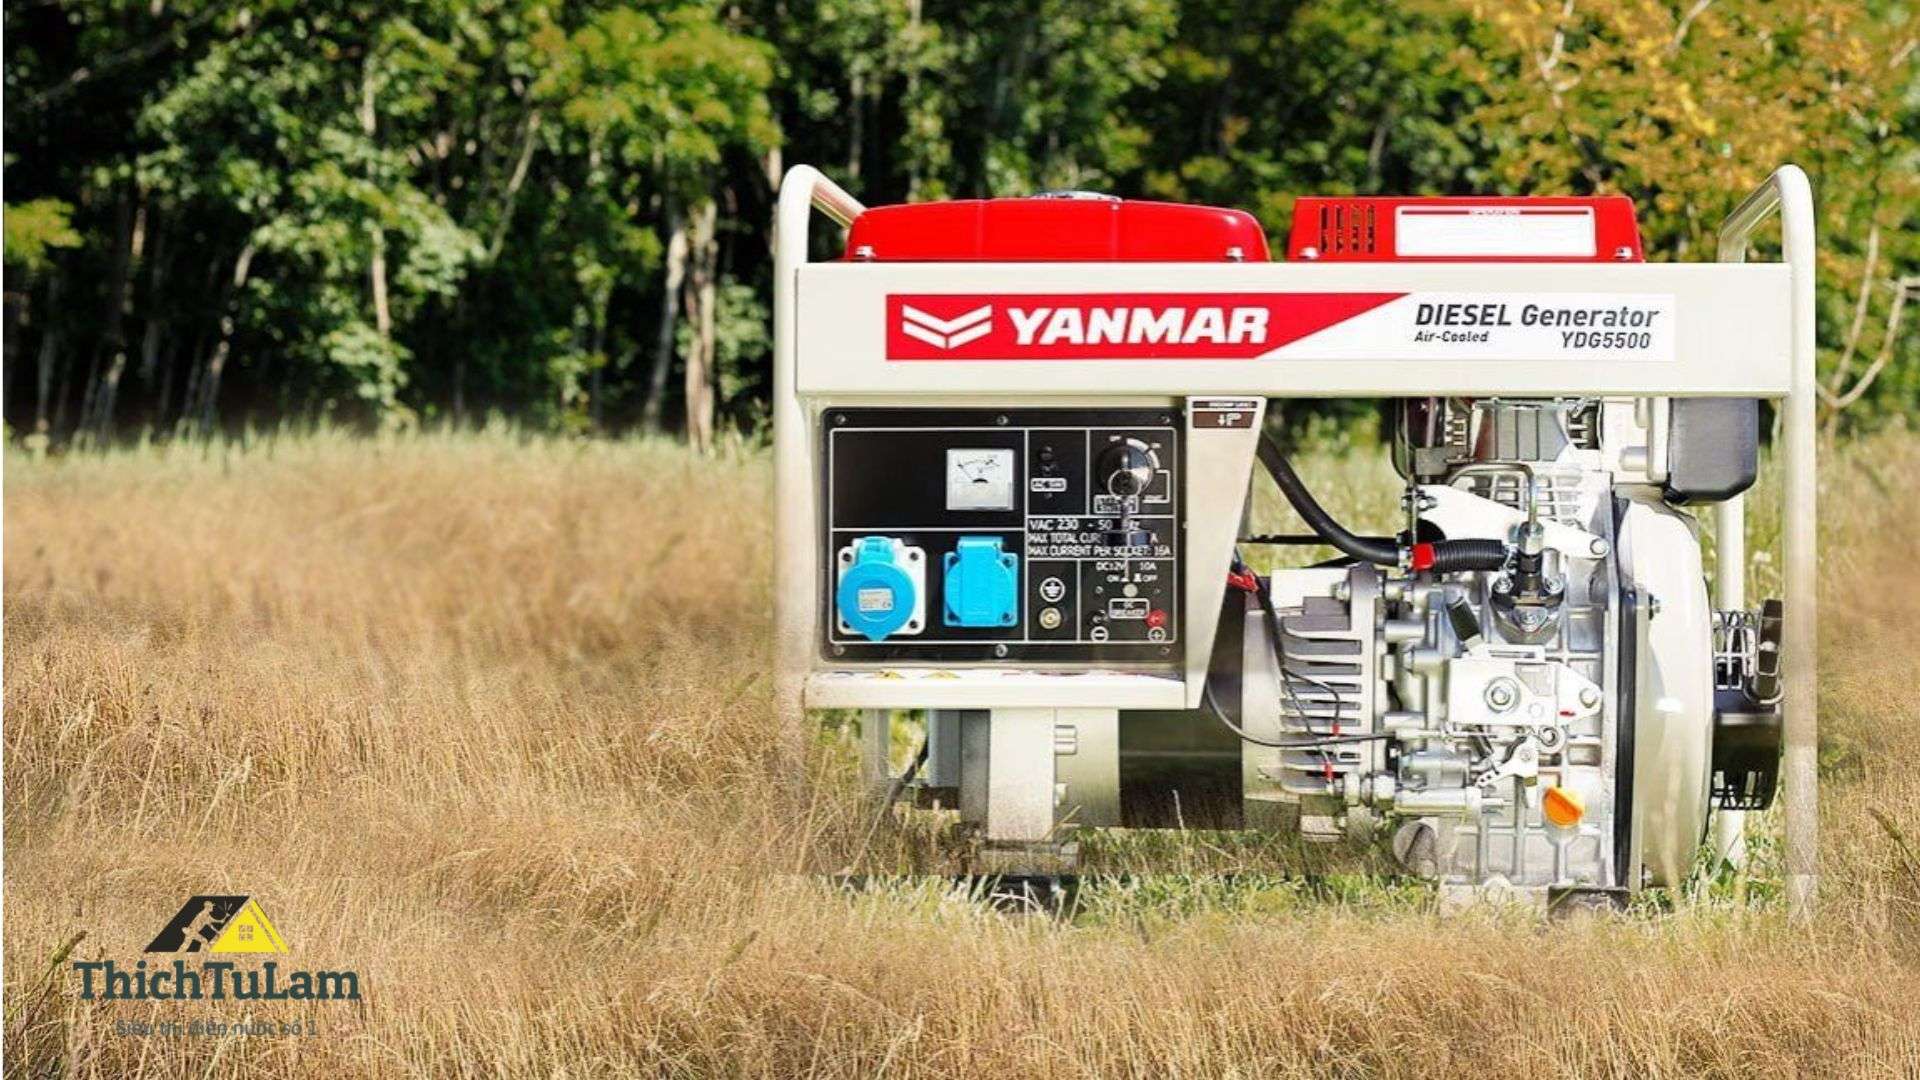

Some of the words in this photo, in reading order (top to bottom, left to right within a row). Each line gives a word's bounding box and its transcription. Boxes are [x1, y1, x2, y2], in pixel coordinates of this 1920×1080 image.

[1415, 304, 1512, 326] DIESEL
[1521, 304, 1660, 327] Generator
[1007, 307, 1269, 345] YANMAR
[1414, 330, 1489, 343] Air-Cooled
[1562, 331, 1652, 349] YDG5500
[1030, 519, 1053, 531] VAC
[1057, 519, 1079, 531] 230
[1099, 519, 1114, 531] 50
